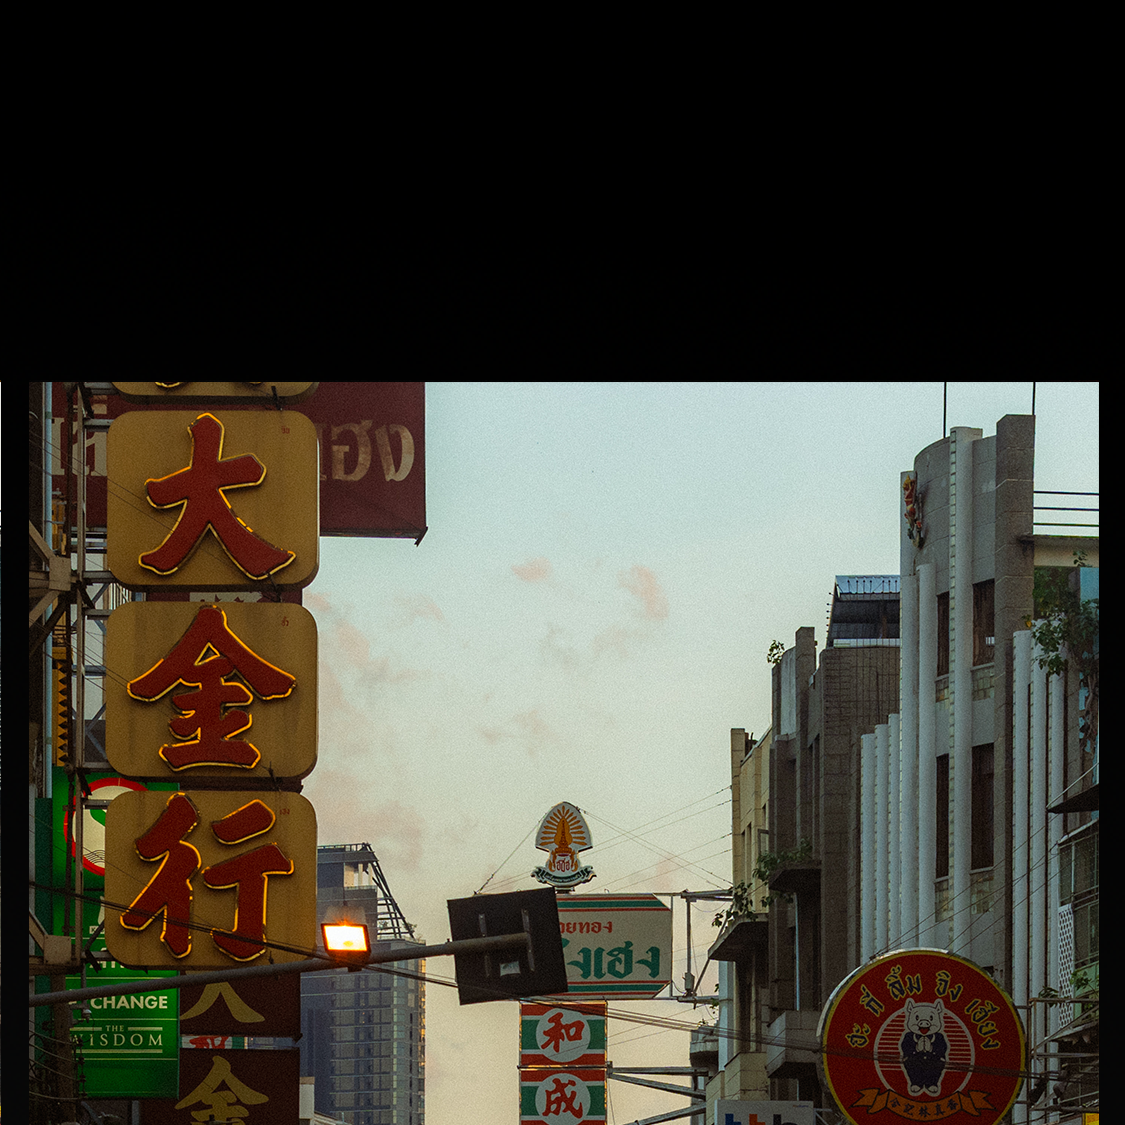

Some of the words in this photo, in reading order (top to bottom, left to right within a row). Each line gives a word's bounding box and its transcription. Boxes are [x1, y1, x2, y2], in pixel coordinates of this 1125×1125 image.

[121, 382, 297, 962] 大金行
[105, 1024, 125, 1033] THE
